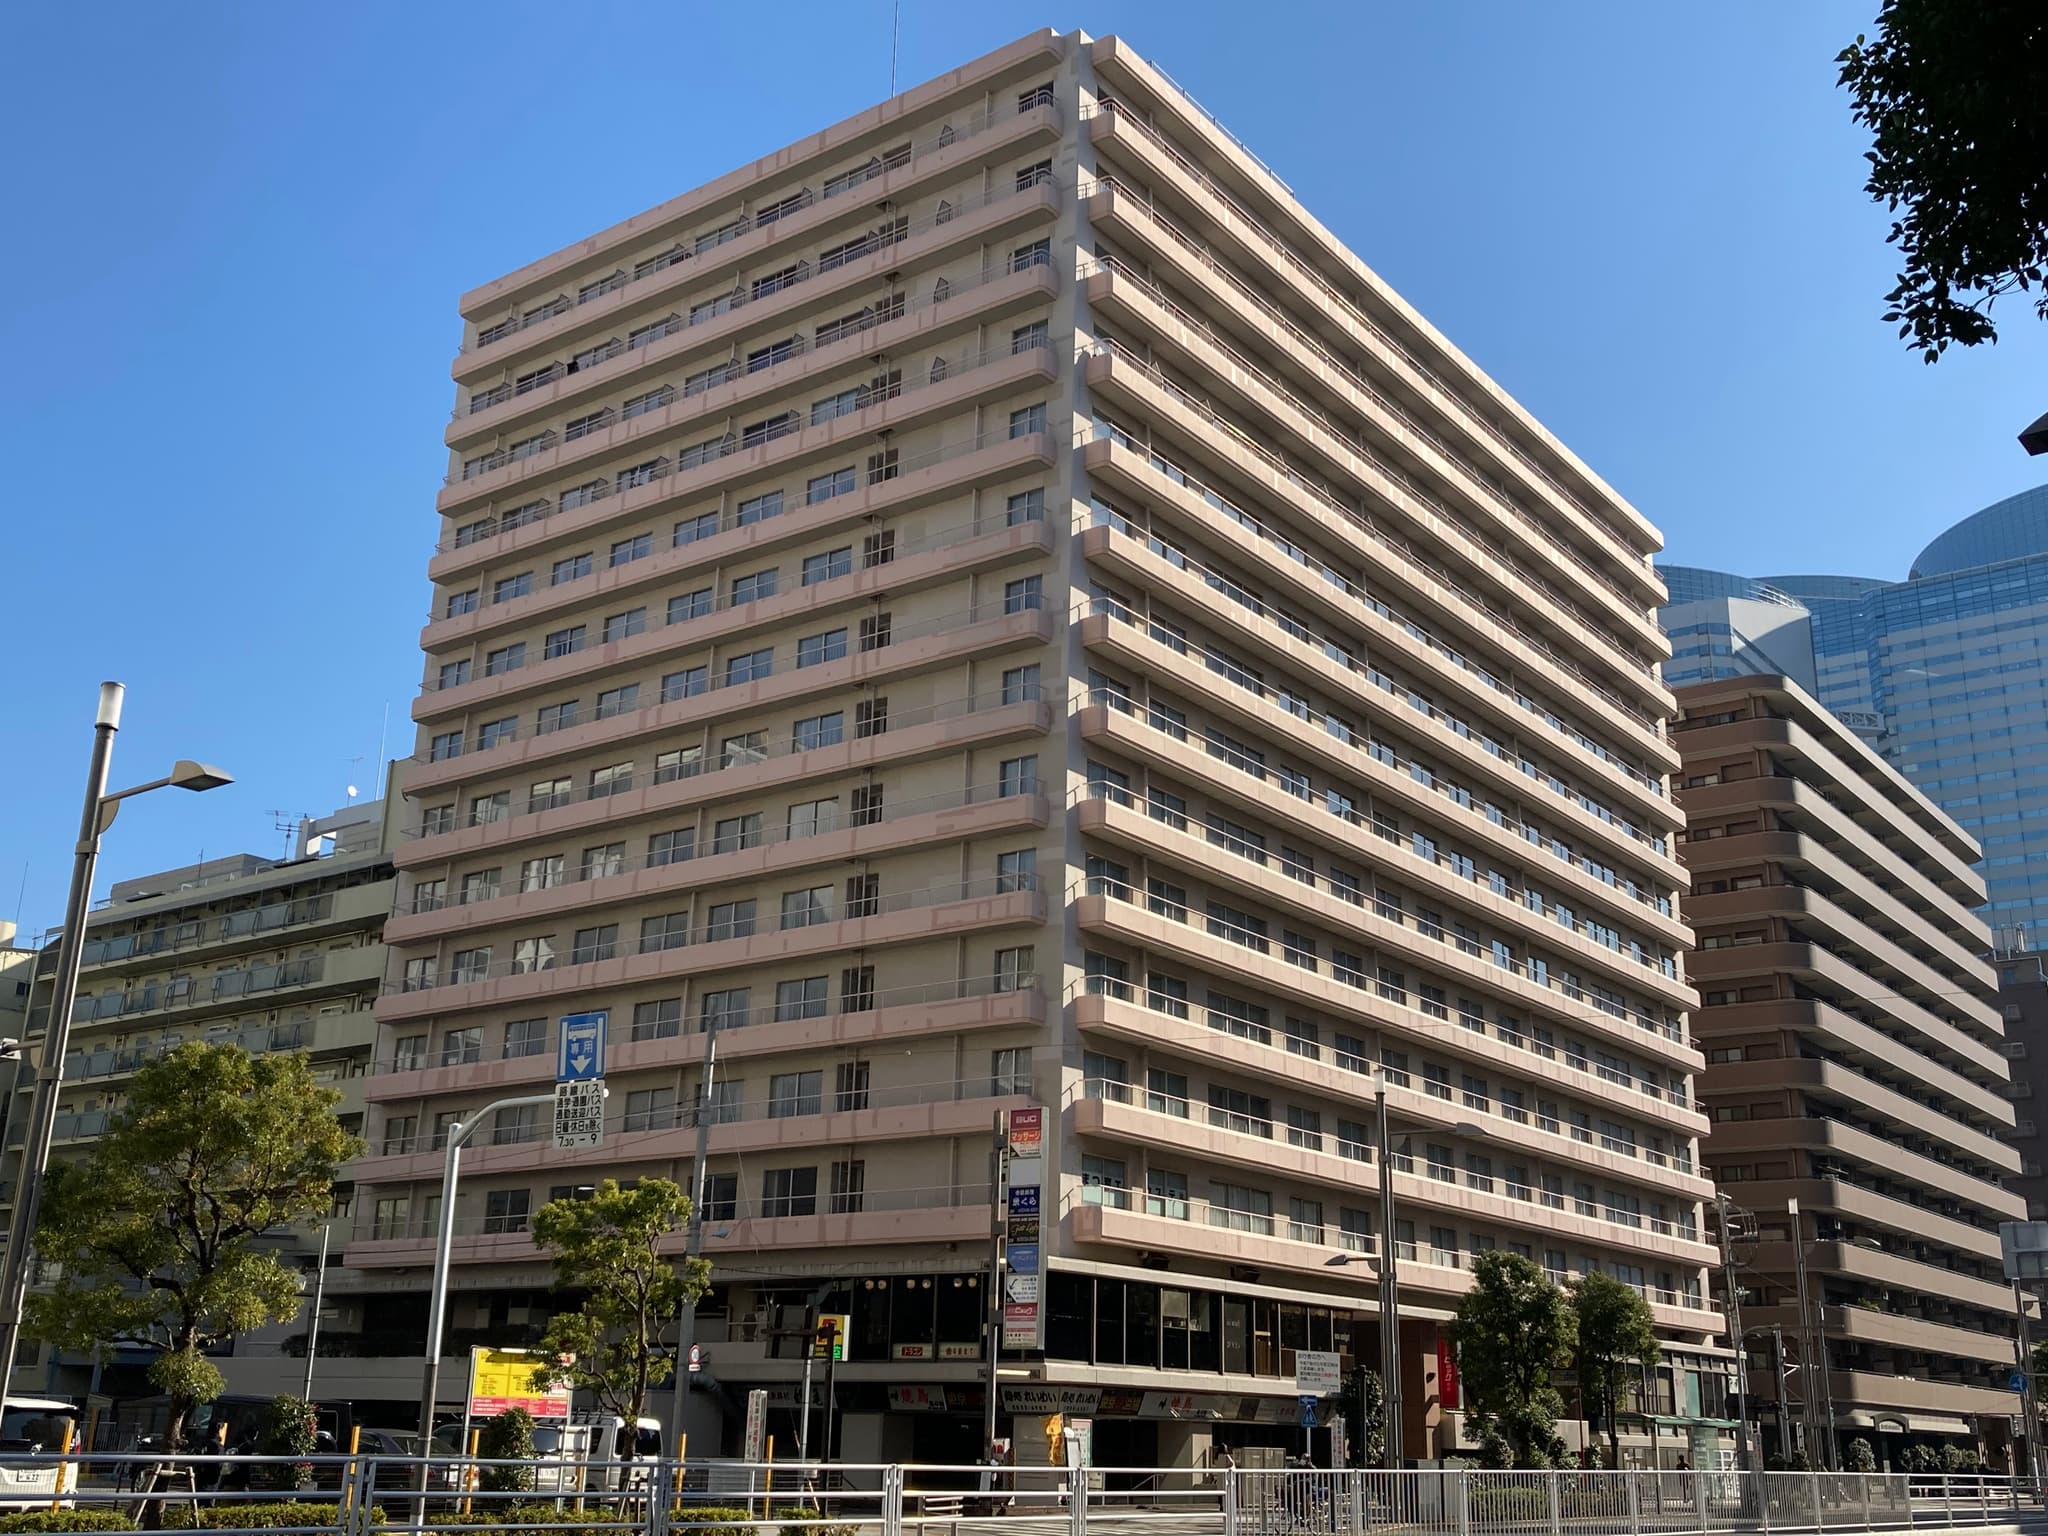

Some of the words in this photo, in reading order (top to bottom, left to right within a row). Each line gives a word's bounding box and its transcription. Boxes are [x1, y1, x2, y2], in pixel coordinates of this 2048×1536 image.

[560, 1083, 600, 1097] 路線バス
[556, 1094, 601, 1109] 通学通園バス
[556, 1106, 601, 1120] 通勤送迎バス
[590, 1133, 597, 1144] 9
